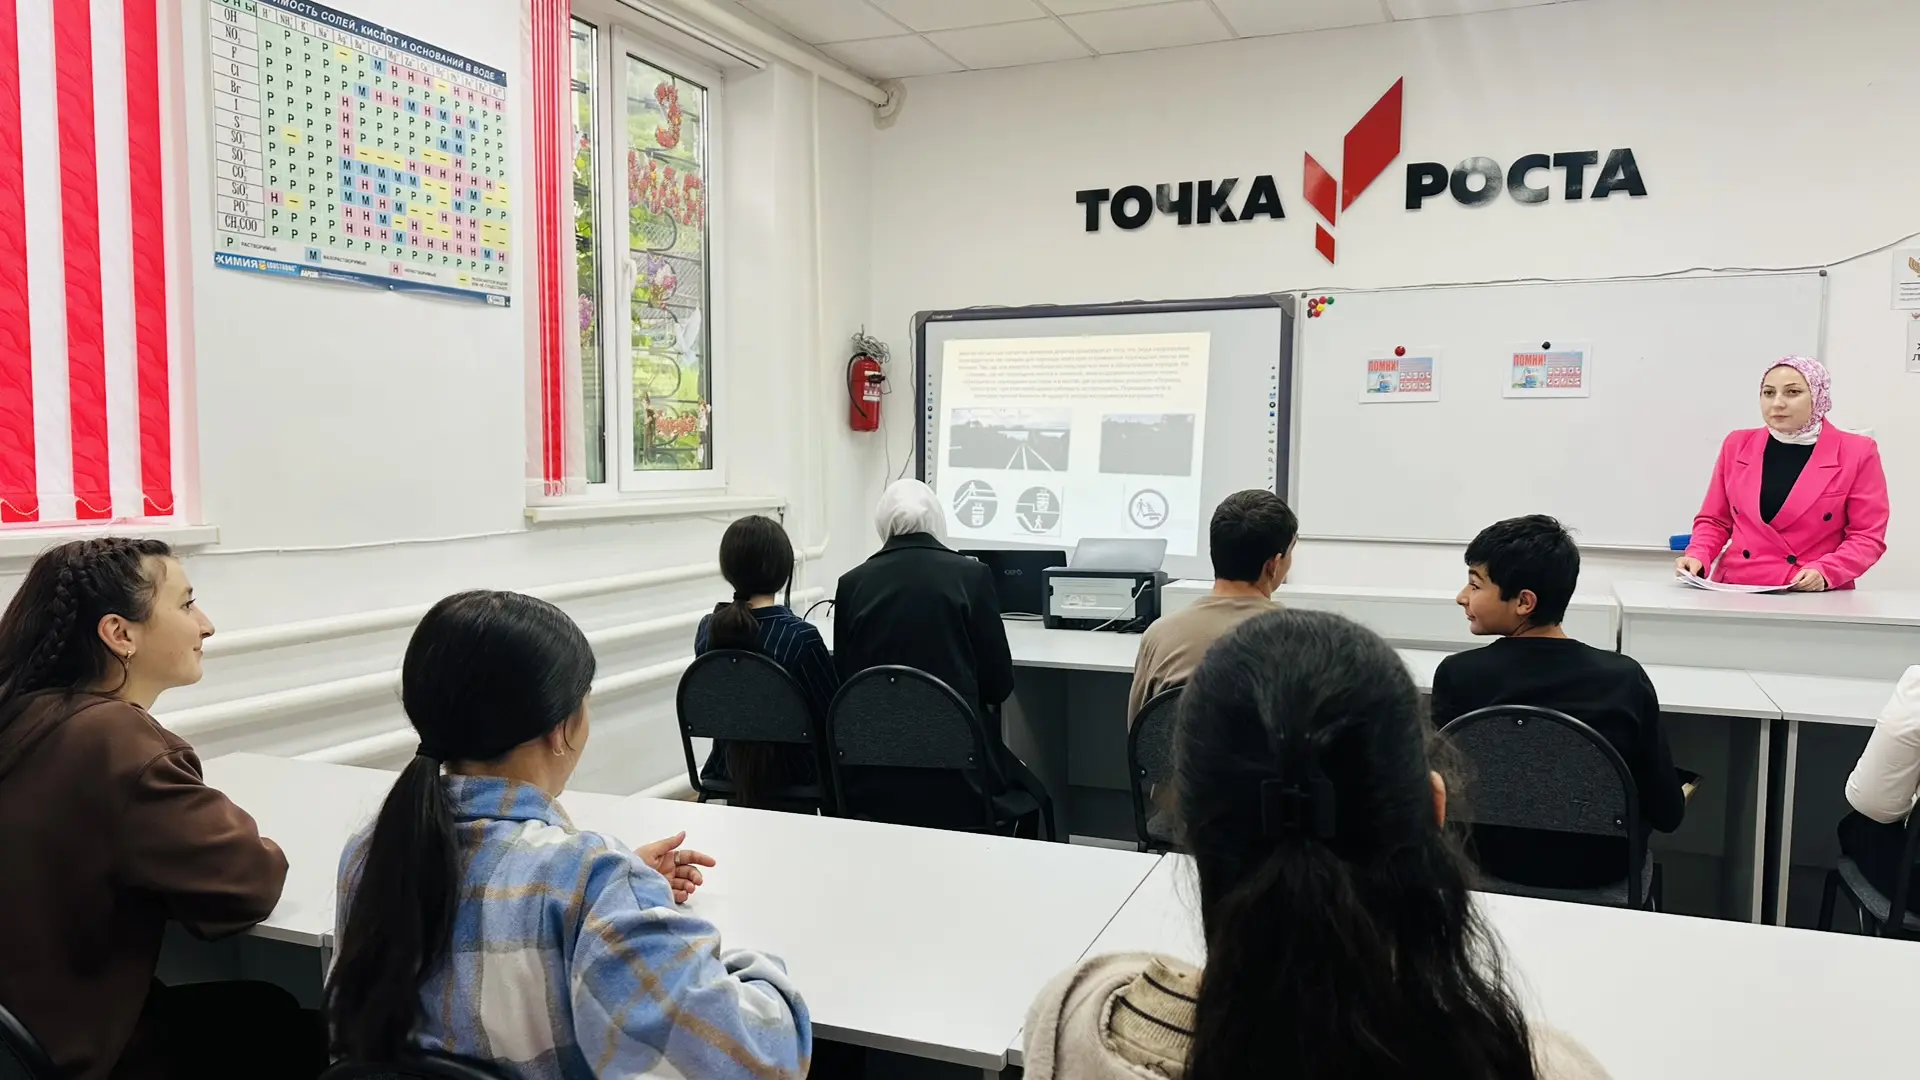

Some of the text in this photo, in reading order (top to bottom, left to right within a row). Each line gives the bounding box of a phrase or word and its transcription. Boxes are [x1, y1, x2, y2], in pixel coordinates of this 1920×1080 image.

[265, 40, 273, 51] Р
[285, 46, 292, 57] Р
[304, 52, 311, 63] Р
[323, 58, 330, 69] Р
[341, 64, 348, 74] Р
[358, 70, 365, 80] Р
[375, 75, 382, 85] Р
[392, 80, 398, 90] Р
[284, 30, 291, 40] Р
[303, 36, 310, 46] Р
[322, 42, 329, 52] Р
[358, 54, 364, 64] Р
[374, 59, 382, 71] М
[391, 65, 398, 76] Н
[321, 11, 359, 33] СОЛЕЙ,
[361, 25, 399, 46] КИСЛОТ
[401, 40, 408, 49] И
[410, 43, 464, 68] ОСНОВАНИЙ
[466, 62, 472, 72] В
[473, 65, 496, 81] ВОДЕ
[266, 57, 273, 68] Р
[286, 63, 293, 74] Р
[305, 69, 312, 79] Р
[323, 75, 331, 85] Р
[341, 80, 348, 90] Р
[358, 85, 366, 97] М
[375, 91, 382, 102] Н
[392, 96, 399, 107] Н
[266, 74, 274, 85] Р
[286, 80, 294, 90] Р
[305, 85, 313, 96] Р
[324, 91, 331, 101] Р
[342, 96, 349, 108] Н
[359, 101, 366, 111] Р
[376, 106, 383, 116] Р
[393, 111, 399, 121] Р
[267, 91, 275, 102] Р
[287, 96, 294, 107] Р
[306, 102, 313, 112] Р
[324, 107, 332, 117] Р
[342, 112, 349, 123] Н
[360, 117, 366, 127] Р
[376, 122, 383, 132] Р
[393, 126, 399, 136] Р
[267, 108, 275, 119] Р
[287, 113, 295, 124] Р
[306, 118, 314, 129] Р
[325, 123, 332, 133] Р
[342, 128, 350, 139] Н
[360, 133, 367, 143] Р
[377, 137, 384, 147] Р
[394, 142, 400, 151] Р
[268, 125, 276, 136] Р
[307, 134, 314, 145] Р
[326, 139, 333, 150] Р
[343, 144, 350, 155] Н
[268, 141, 276, 152] Р
[288, 146, 296, 157] Р
[307, 151, 315, 161] Р
[326, 155, 333, 166] Р
[343, 159, 351, 171] М
[360, 164, 369, 175] М
[378, 168, 386, 179] М
[394, 172, 402, 182] М
[269, 158, 277, 169] Р
[289, 163, 297, 173] Р
[308, 167, 315, 177] Р
[326, 171, 333, 182] Р
[343, 175, 352, 186] М
[361, 179, 369, 190] Н
[378, 183, 386, 194] М
[395, 187, 401, 197] Р
[270, 175, 403, 213] Р Р Р Р М М Н М
[270, 192, 279, 203] Н
[309, 199, 316, 210] Р
[327, 203, 335, 214] Р
[345, 207, 353, 218] Н
[363, 210, 370, 221] Н
[379, 214, 387, 224] М
[1075, 148, 1648, 232] ТОЧКА РОСТА
[227, 237, 234, 247] Р
[271, 208, 279, 219] Р
[291, 212, 298, 223] Р
[310, 216, 317, 226] Р
[328, 219, 336, 229] Р
[346, 223, 353, 234] Н
[363, 226, 371, 237] Н
[380, 229, 387, 240] Н
[395, 232, 403, 243] М
[272, 225, 279, 236] Р
[291, 229, 299, 239] Р
[310, 232, 318, 242] Р
[329, 235, 336, 245] Р
[346, 238, 354, 249] Р
[364, 241, 371, 251] Р
[381, 244, 387, 254] Р
[396, 247, 403, 257] Р
[216, 254, 258, 269] ХИМИЯ
[309, 250, 317, 260] М
[393, 264, 399, 273] Н
[1368, 359, 1399, 373] ПОМНИ!
[1513, 353, 1546, 367] ПОМНИ!
